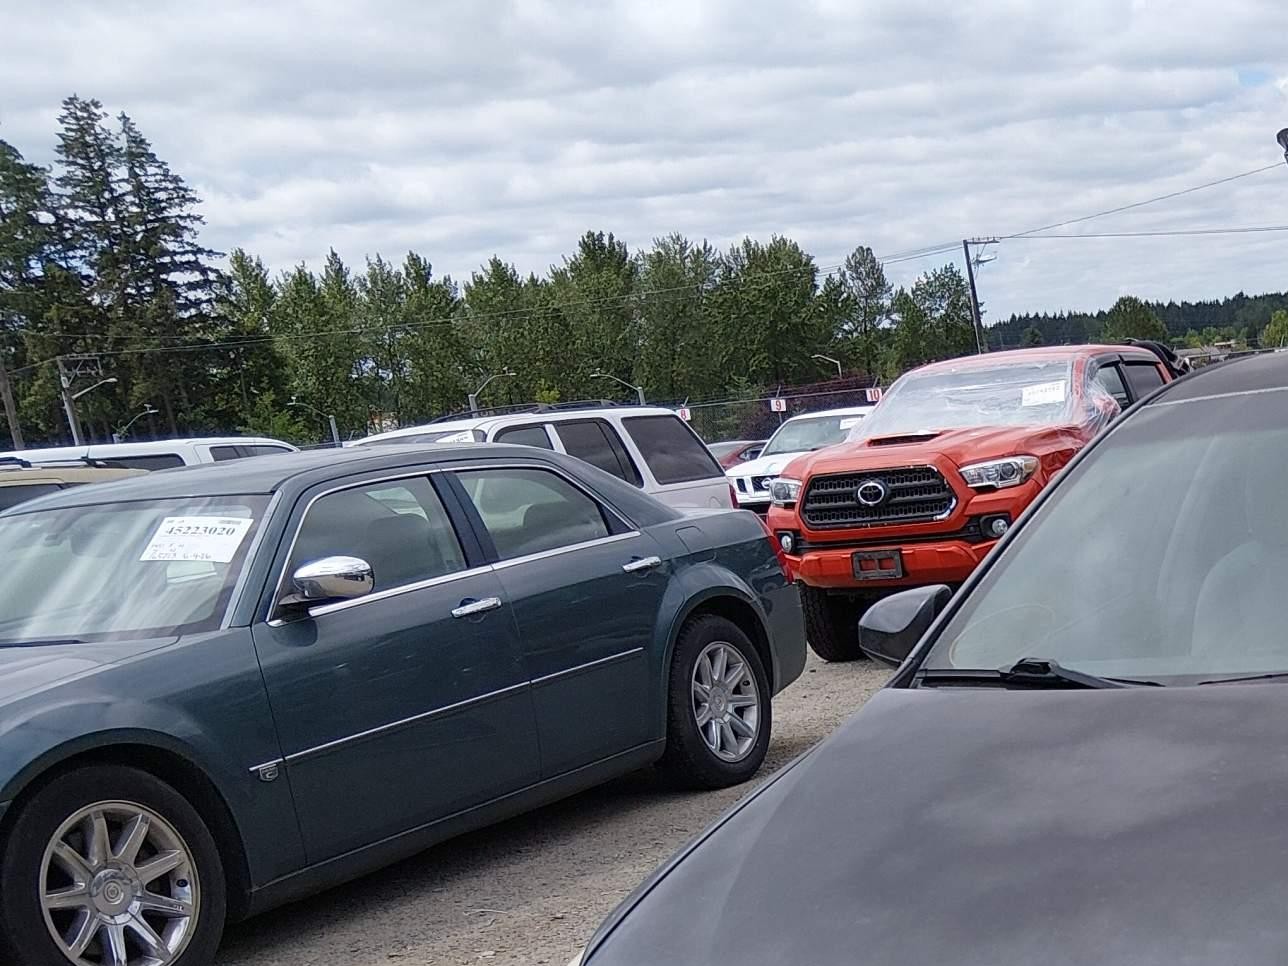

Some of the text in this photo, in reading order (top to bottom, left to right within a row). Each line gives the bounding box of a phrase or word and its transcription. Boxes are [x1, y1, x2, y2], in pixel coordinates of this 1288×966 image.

[868, 389, 880, 400] 10
[775, 400, 782, 411] 9
[680, 410, 687, 420] 8
[165, 526, 236, 535] 45223020
